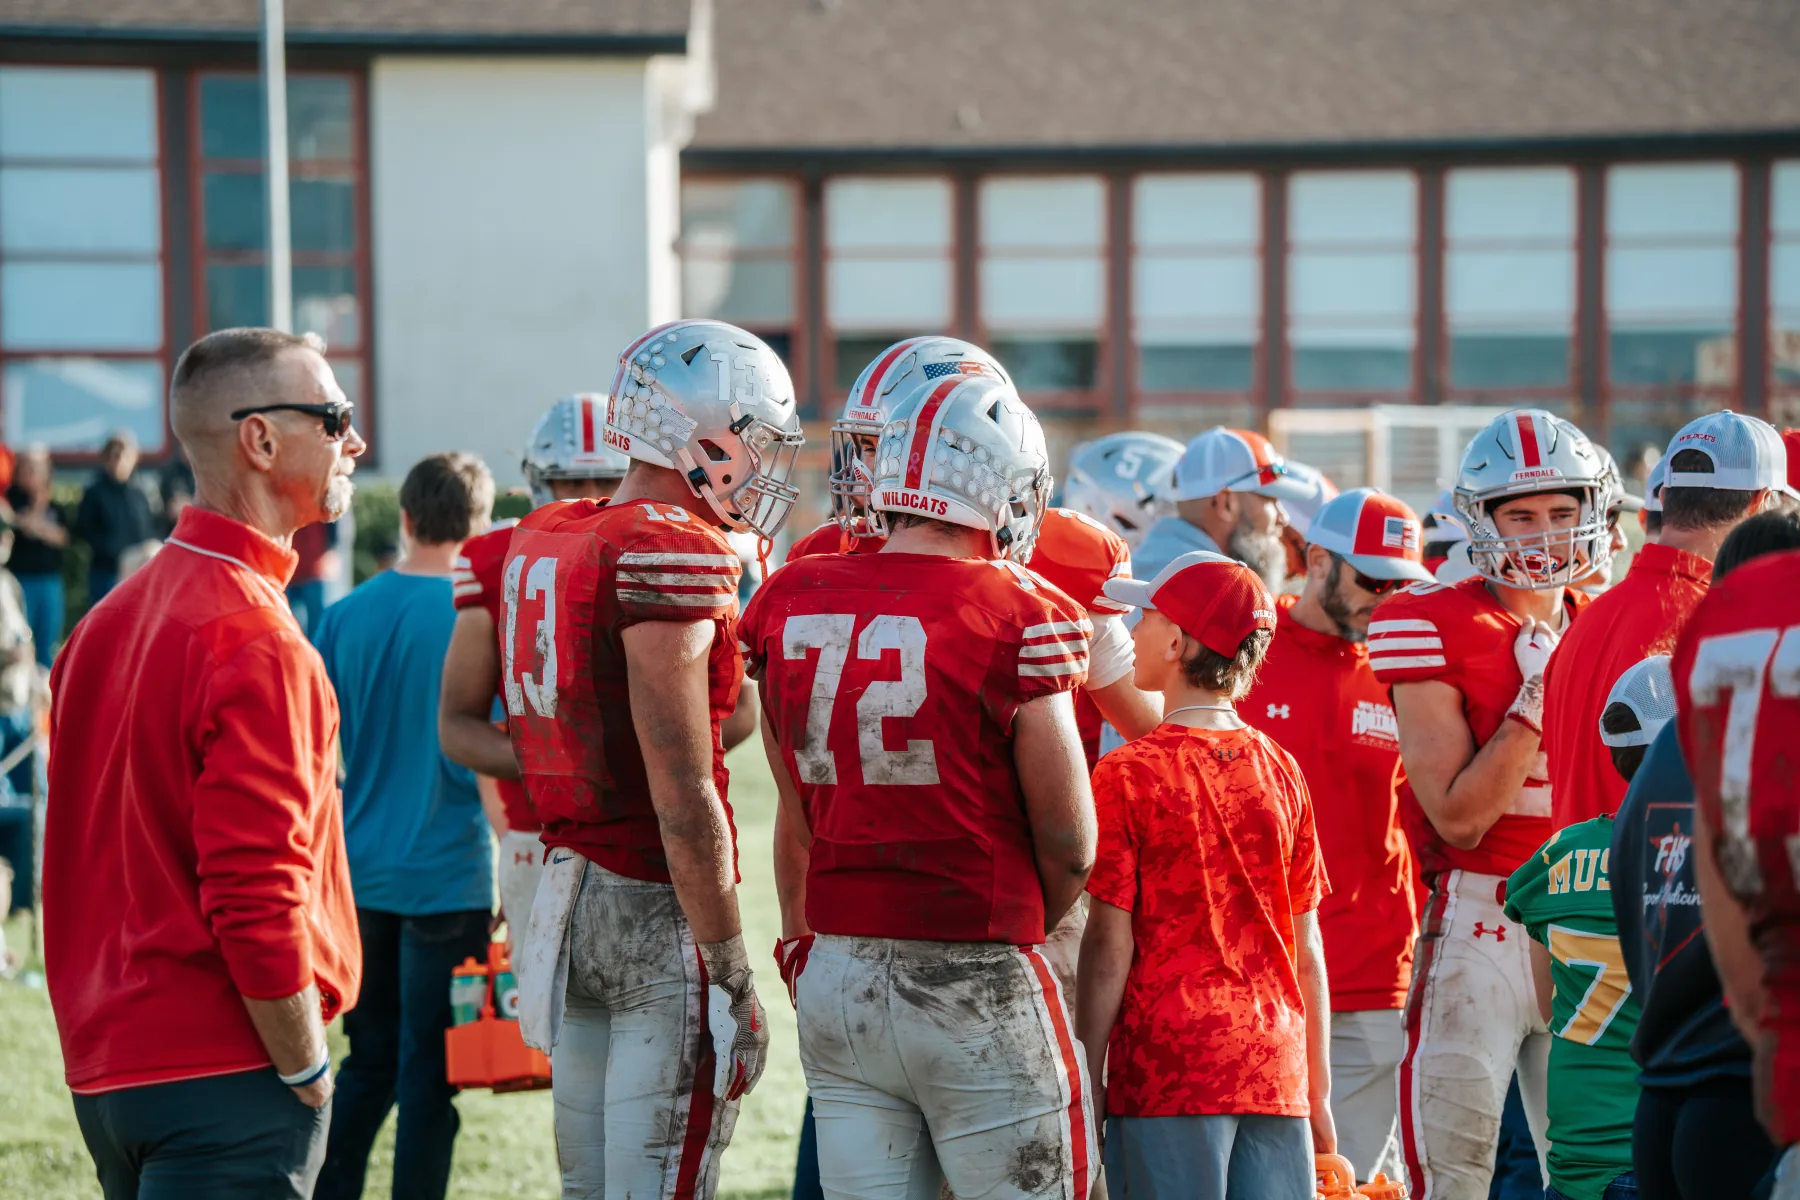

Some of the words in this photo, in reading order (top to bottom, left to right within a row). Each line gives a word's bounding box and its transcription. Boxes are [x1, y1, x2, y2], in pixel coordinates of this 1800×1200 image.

[710, 352, 762, 406] 13
[848, 409, 877, 420] FERNDALE
[1515, 469, 1555, 480] FERNDALE
[642, 503, 691, 523] 13
[882, 491, 948, 516] WILDCATS
[504, 555, 559, 719] 13
[782, 613, 941, 786] 72
[1654, 835, 1690, 874] FHS
[1547, 923, 1632, 1046] 7
